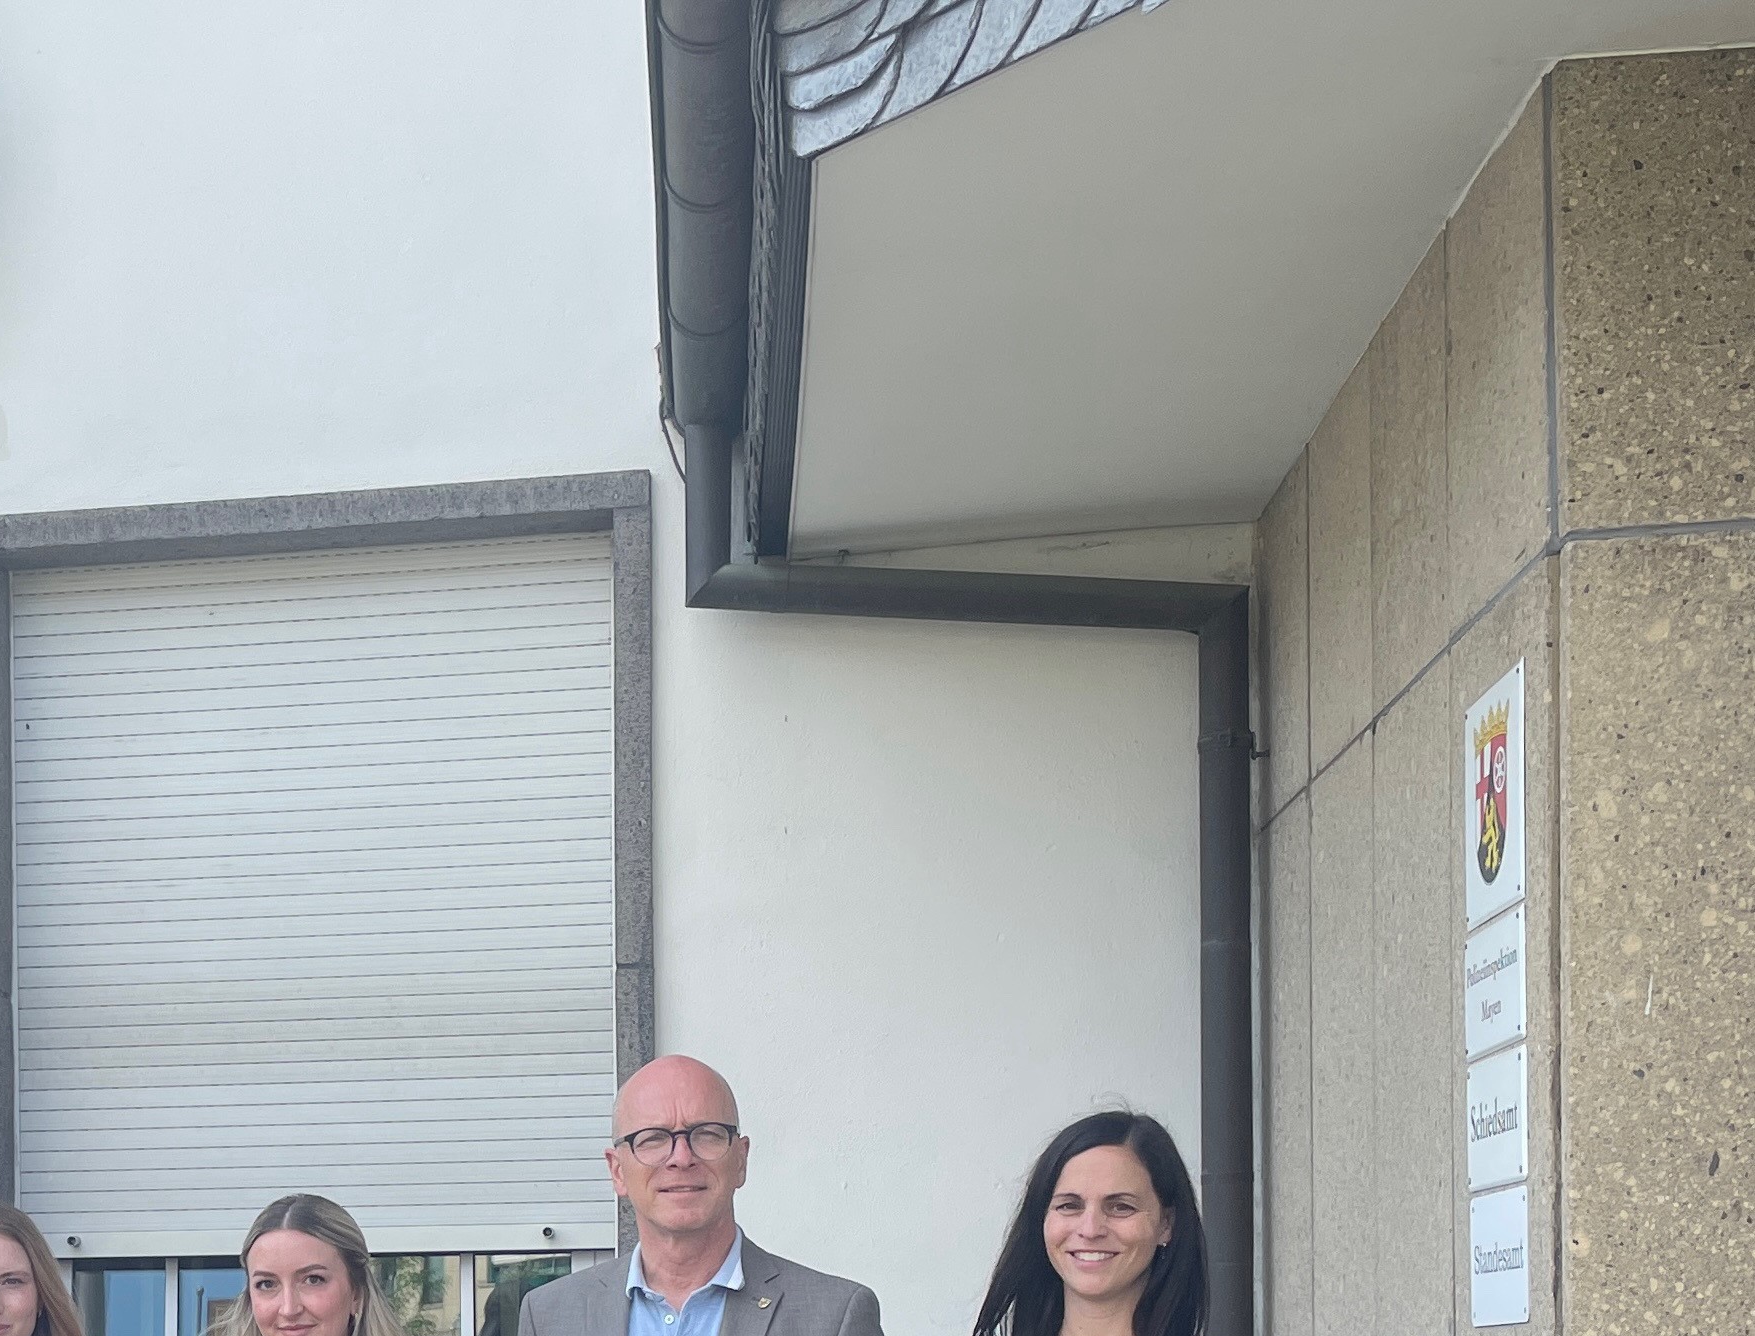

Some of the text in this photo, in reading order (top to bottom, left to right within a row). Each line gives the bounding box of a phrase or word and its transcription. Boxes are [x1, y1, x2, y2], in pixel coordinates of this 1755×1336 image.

[1480, 999, 1502, 1023] Mayen
[1471, 1096, 1518, 1142] Schiedsamt
[1474, 1238, 1524, 1275] Standesamt
